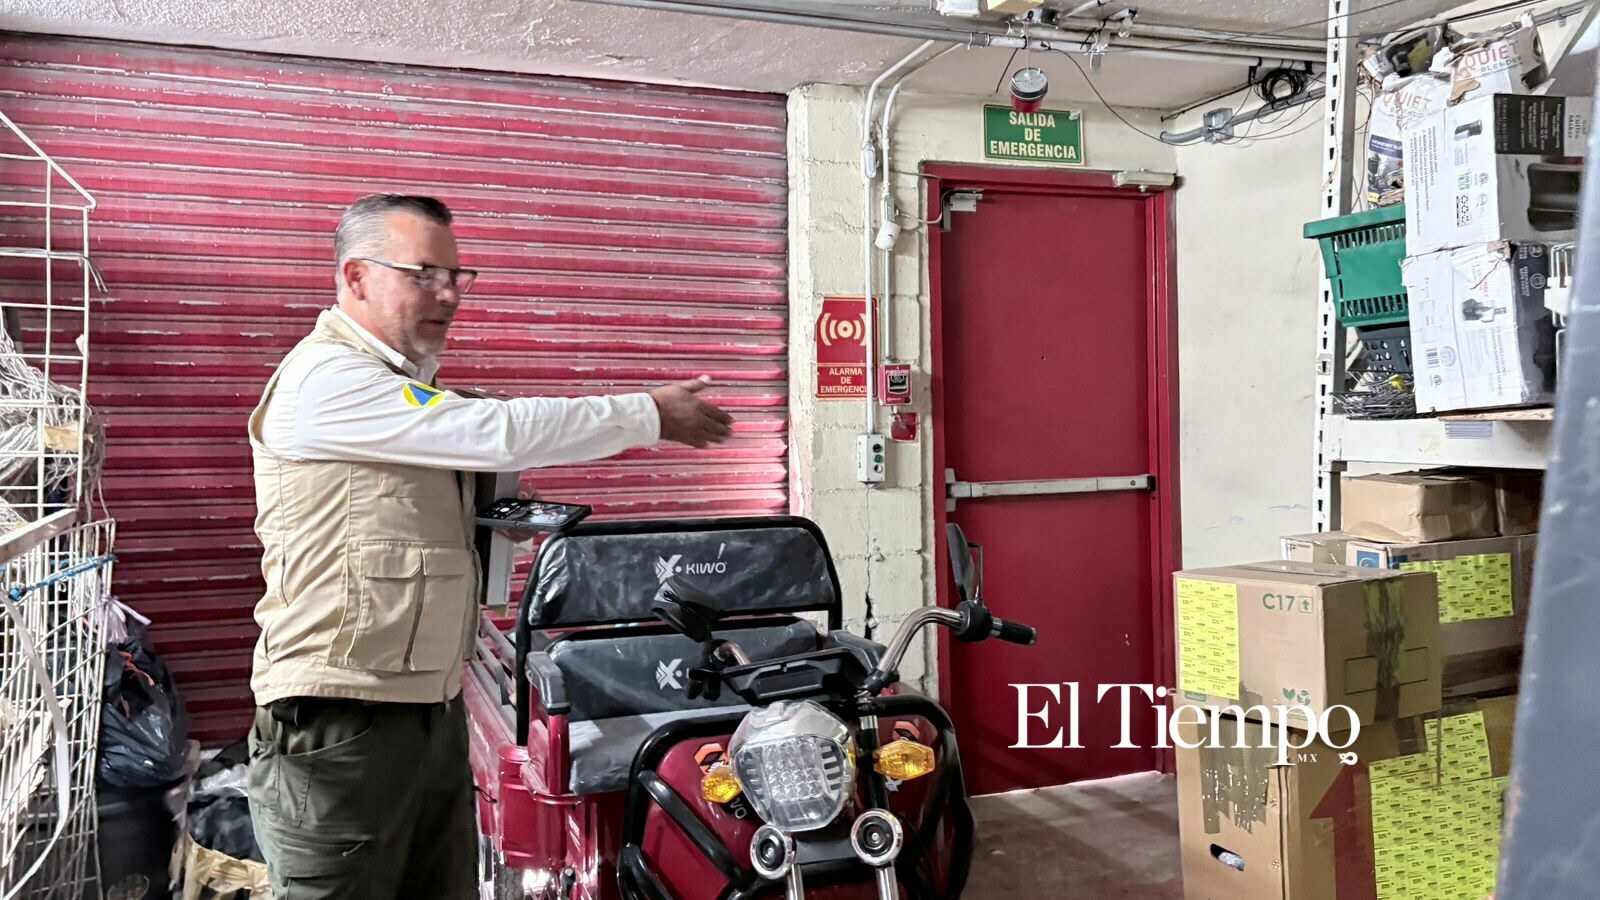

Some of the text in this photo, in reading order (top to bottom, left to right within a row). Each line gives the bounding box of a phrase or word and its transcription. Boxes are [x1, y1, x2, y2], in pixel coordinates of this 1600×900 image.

[1465, 40, 1520, 70] QUIET
[1009, 111, 1056, 128] SALIDA
[1024, 128, 1042, 142] DE
[990, 140, 1077, 159] EMERGENCIA
[829, 367, 863, 375] ALARMA
[840, 376, 852, 384] DE
[820, 385, 867, 393] EMERGENCI
[1262, 593, 1296, 611] C17
